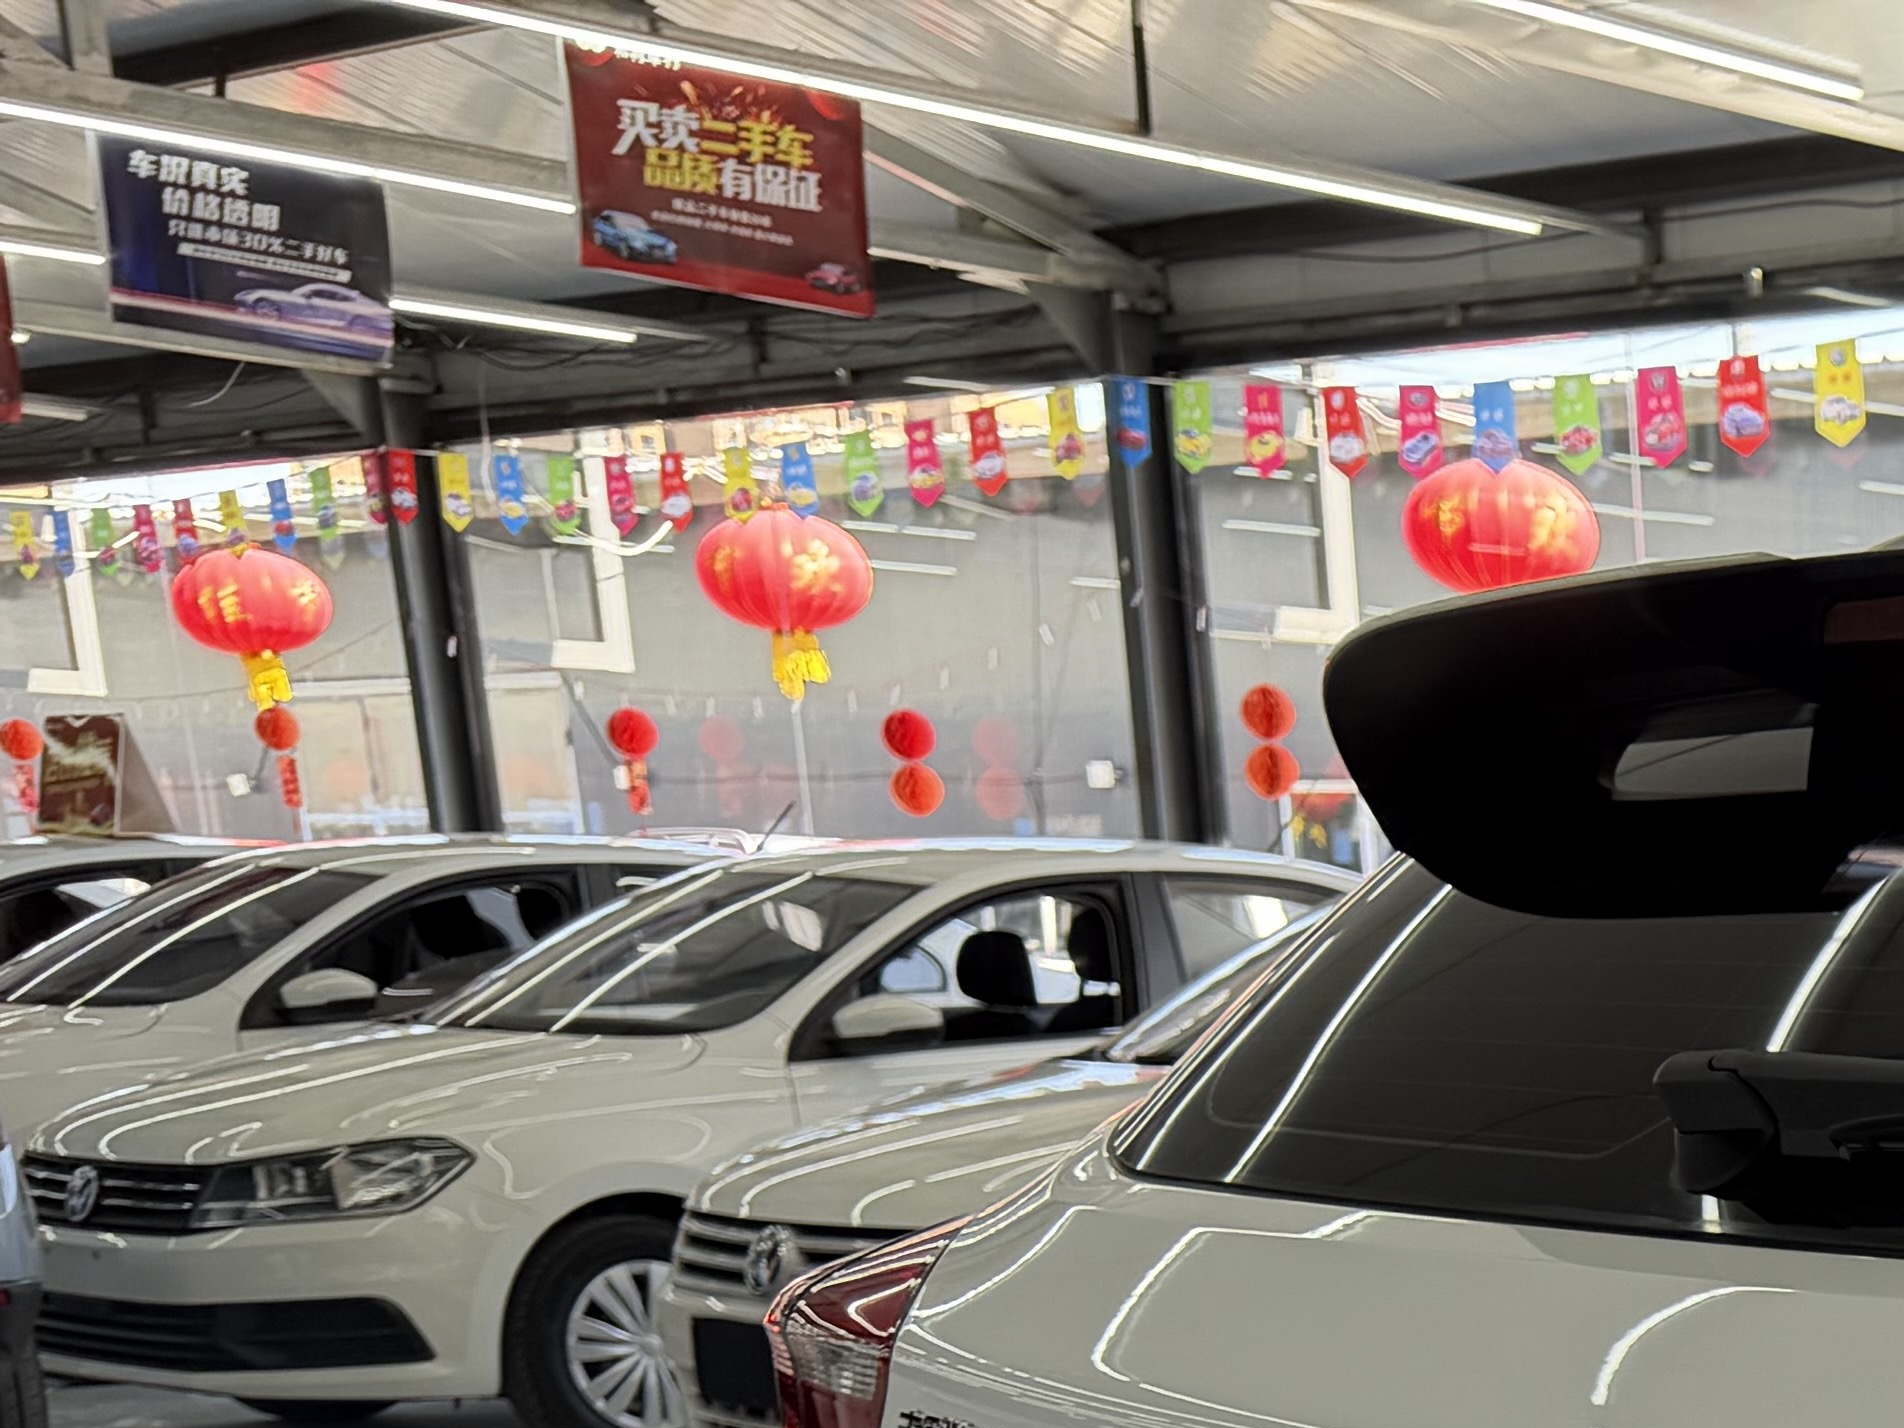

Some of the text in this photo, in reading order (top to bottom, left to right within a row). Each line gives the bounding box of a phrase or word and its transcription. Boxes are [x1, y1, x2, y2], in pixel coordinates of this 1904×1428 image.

[611, 97, 815, 169] 买卖二手车
[126, 148, 250, 197] 车况真实
[642, 146, 824, 213] 品质有保证
[161, 186, 281, 232] 价格透明
